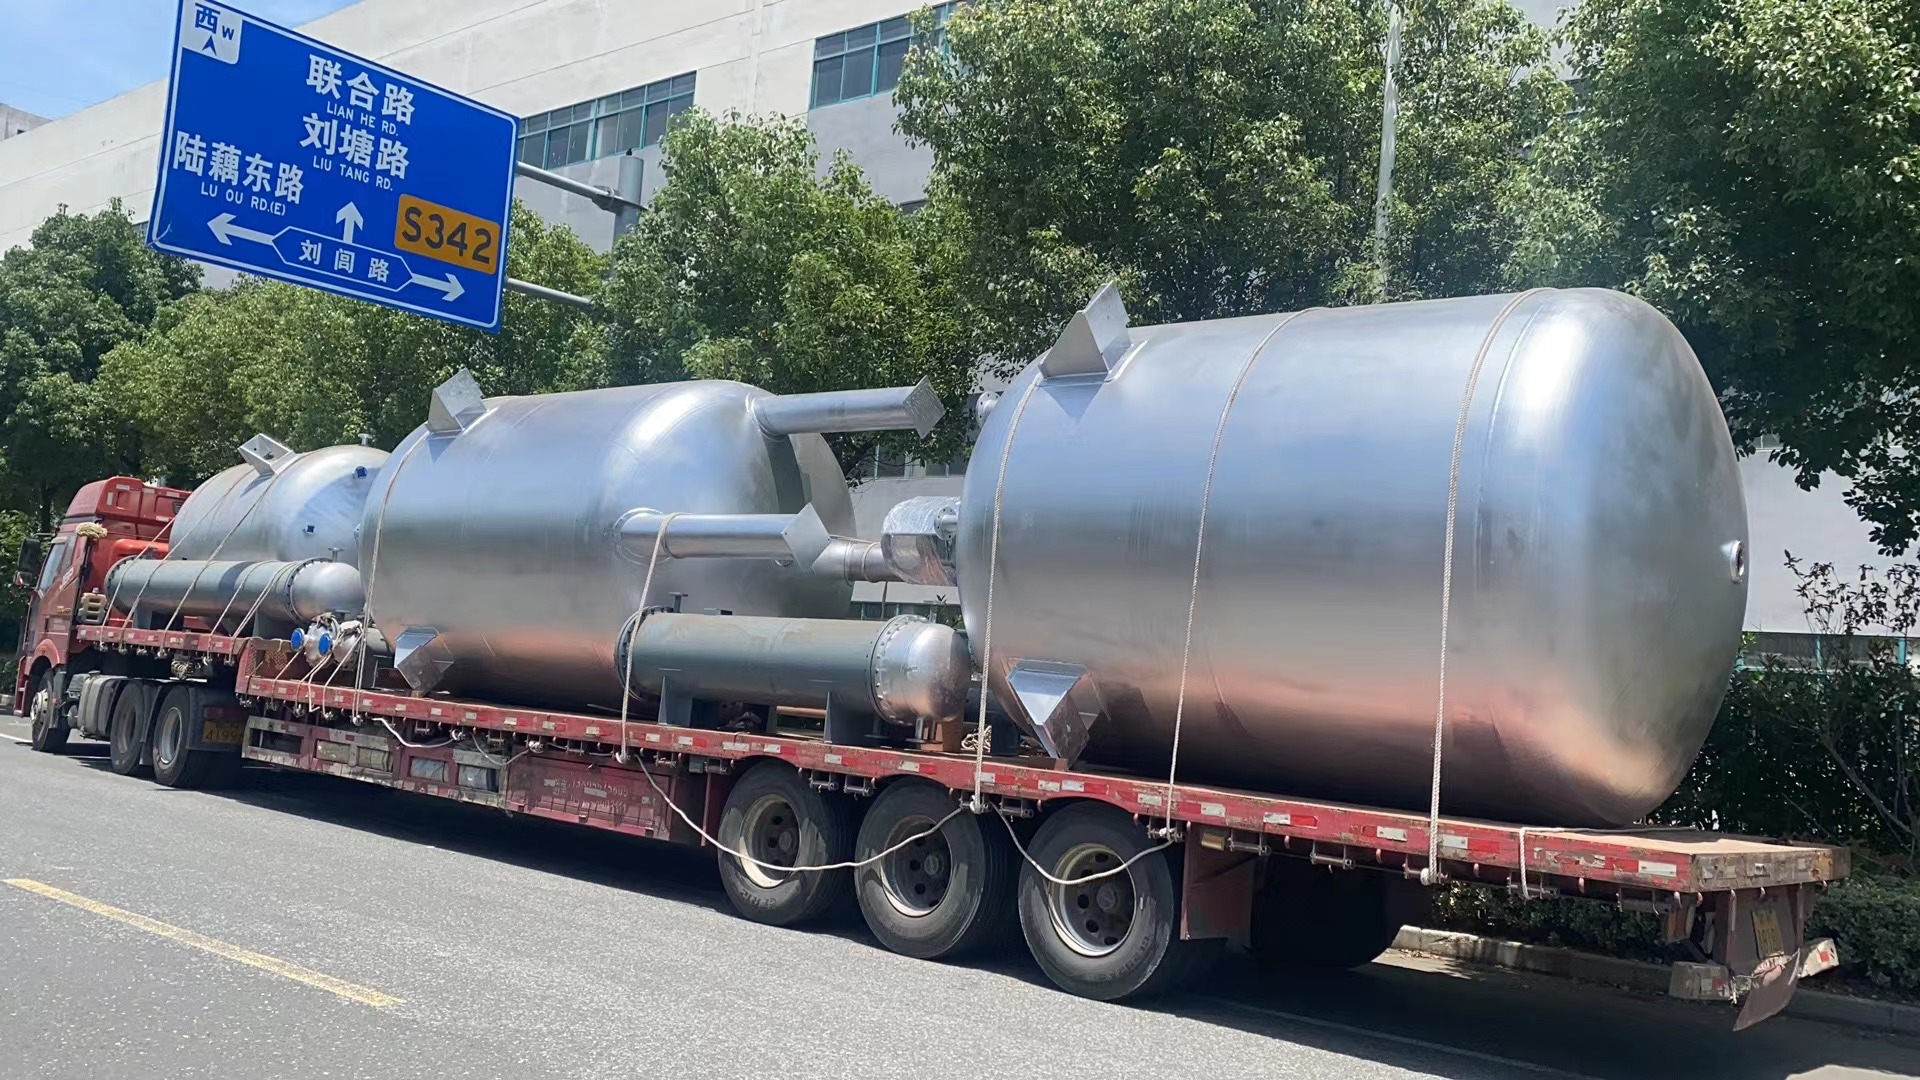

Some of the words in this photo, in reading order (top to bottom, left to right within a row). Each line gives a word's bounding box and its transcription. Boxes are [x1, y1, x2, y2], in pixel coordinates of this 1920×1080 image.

[194, 2, 221, 34] 西
[222, 25, 235, 41] W
[306, 53, 415, 125] 联合路
[326, 101, 354, 121] LIAN
[360, 112, 376, 129] HE
[381, 120, 399, 137] RD.
[172, 130, 304, 204] 陆藕东路
[299, 112, 410, 180] 刘塘路
[312, 155, 332, 172] LIU
[339, 163, 370, 184] TANG
[375, 175, 393, 192] RD.
[200, 181, 218, 198] LU
[225, 188, 244, 205] OU
[250, 195, 286, 217] RD.(E)
[401, 206, 493, 265] S342
